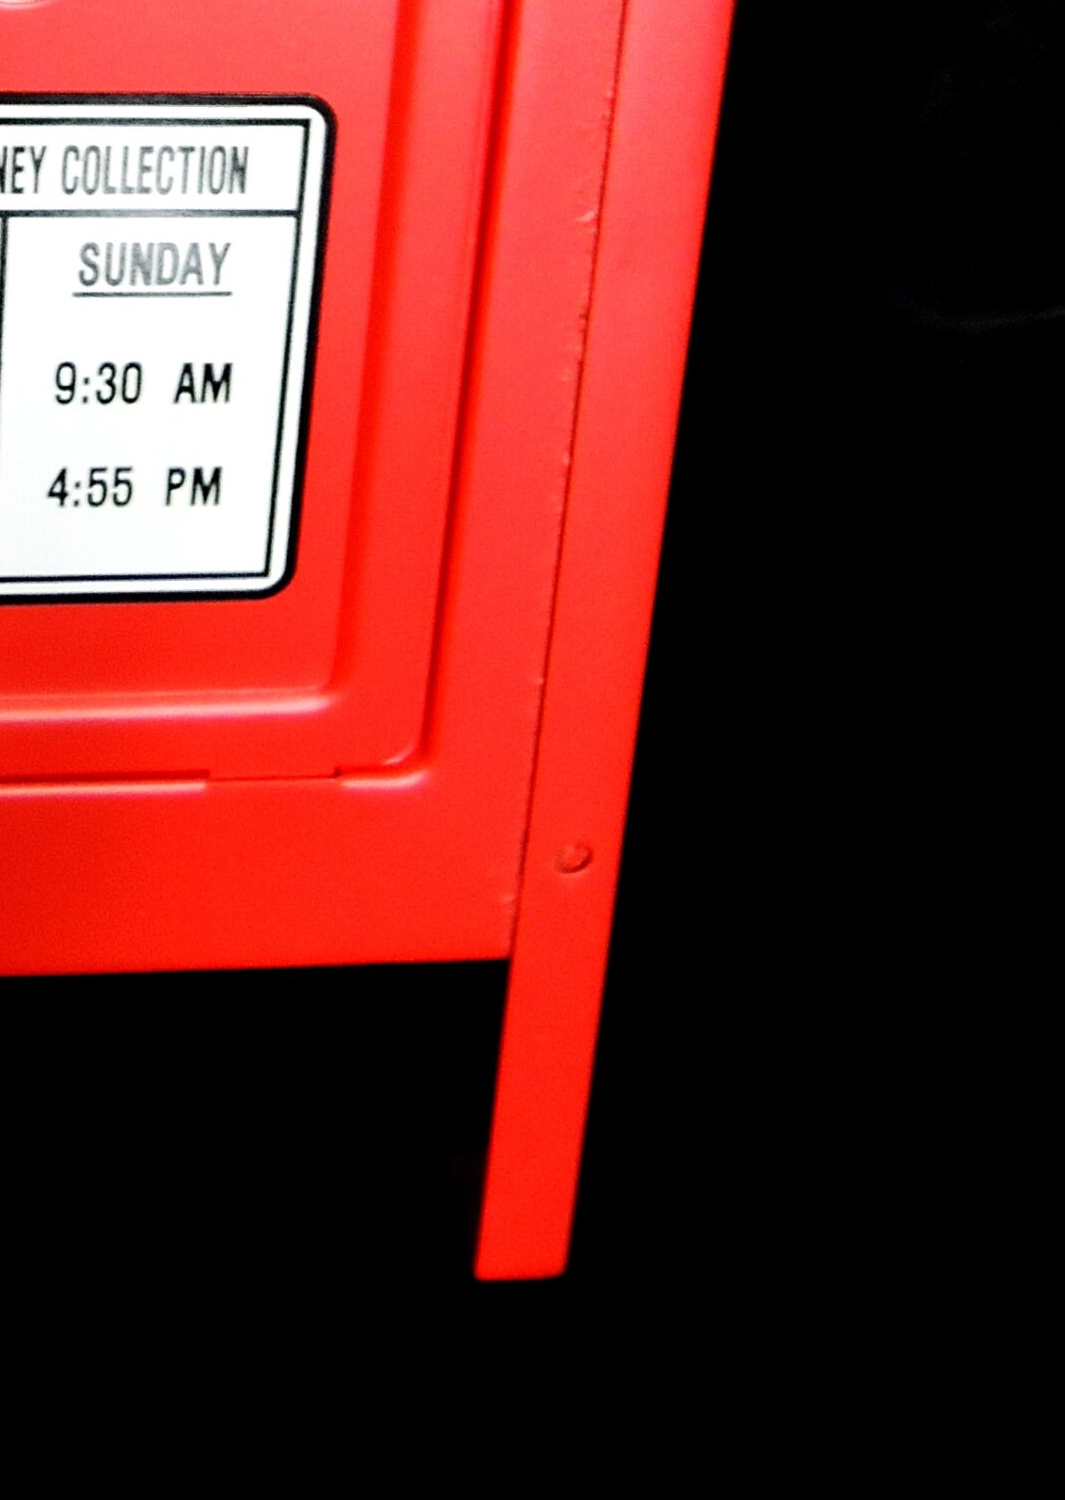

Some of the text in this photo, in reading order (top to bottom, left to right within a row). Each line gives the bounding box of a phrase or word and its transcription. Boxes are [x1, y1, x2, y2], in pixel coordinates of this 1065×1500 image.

[61, 145, 250, 195] COLLECTION
[78, 242, 232, 287] SUNDAY
[55, 362, 233, 405] 9:30 AM
[47, 466, 223, 508] 4:55 PM
